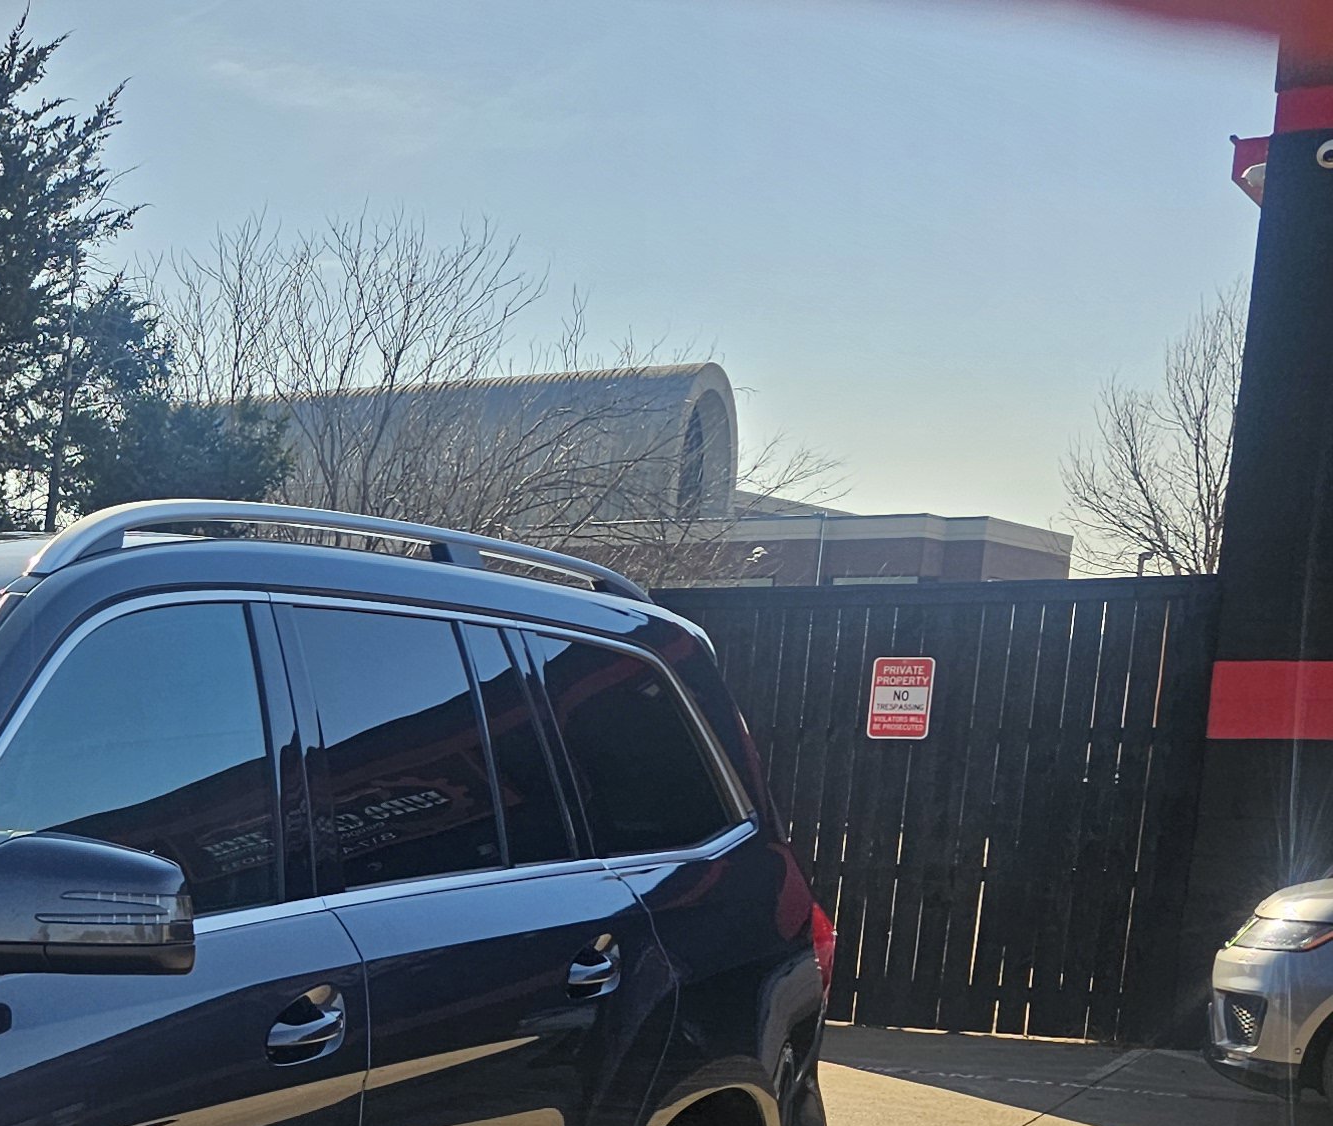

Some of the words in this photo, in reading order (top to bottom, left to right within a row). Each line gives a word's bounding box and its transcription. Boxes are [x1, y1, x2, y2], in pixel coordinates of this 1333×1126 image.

[883, 665, 925, 675] PRIVATE
[875, 676, 930, 686] PROPERTY
[893, 690, 909, 701] NO
[876, 703, 924, 711] TRESPASSING
